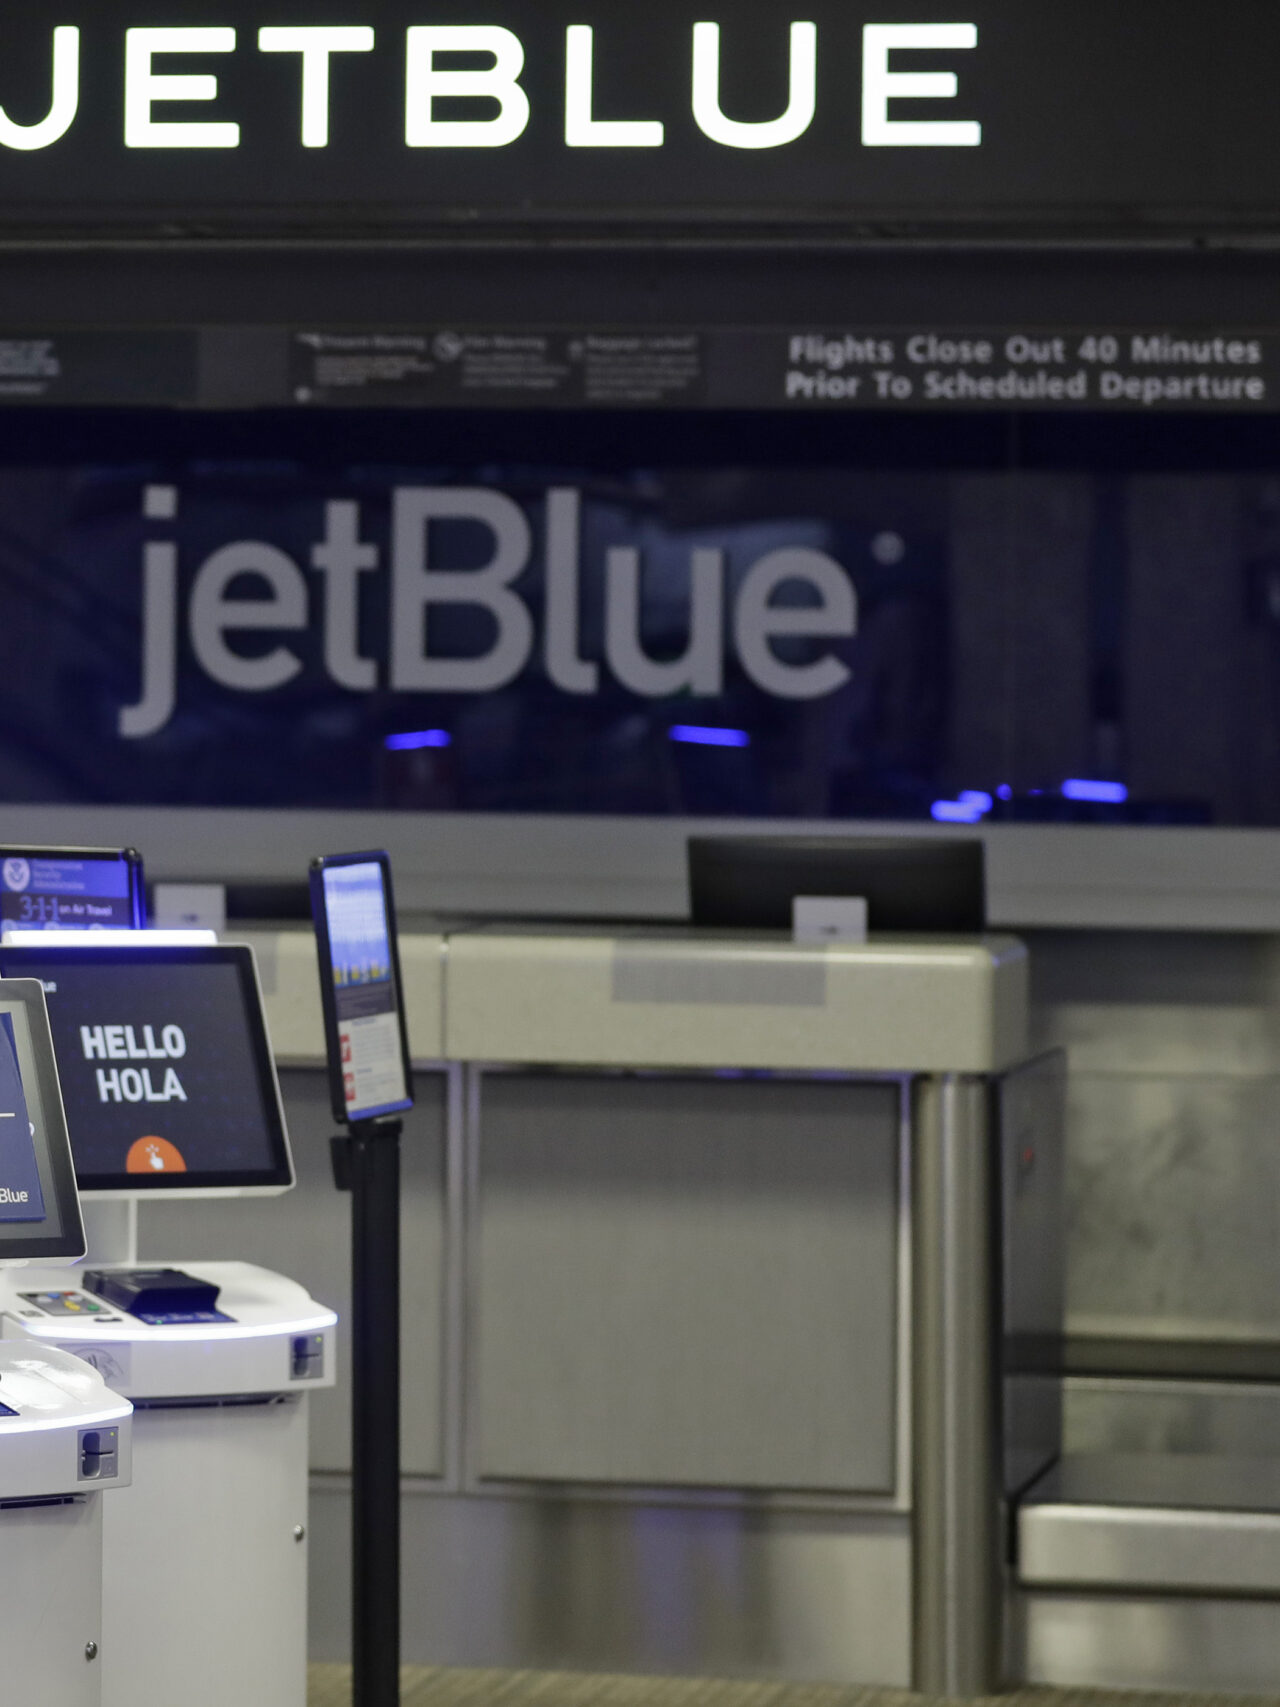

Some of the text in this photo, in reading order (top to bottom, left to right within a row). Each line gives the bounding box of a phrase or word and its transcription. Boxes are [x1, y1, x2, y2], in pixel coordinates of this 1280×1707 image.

[788, 335, 1261, 371] Flights Close Out 40 Minutes
[785, 370, 1265, 405] Prior To Scheduled Departure
[118, 484, 858, 738] jetBlue
[80, 1024, 187, 1060] HELLO
[95, 1067, 188, 1103] HOLA
